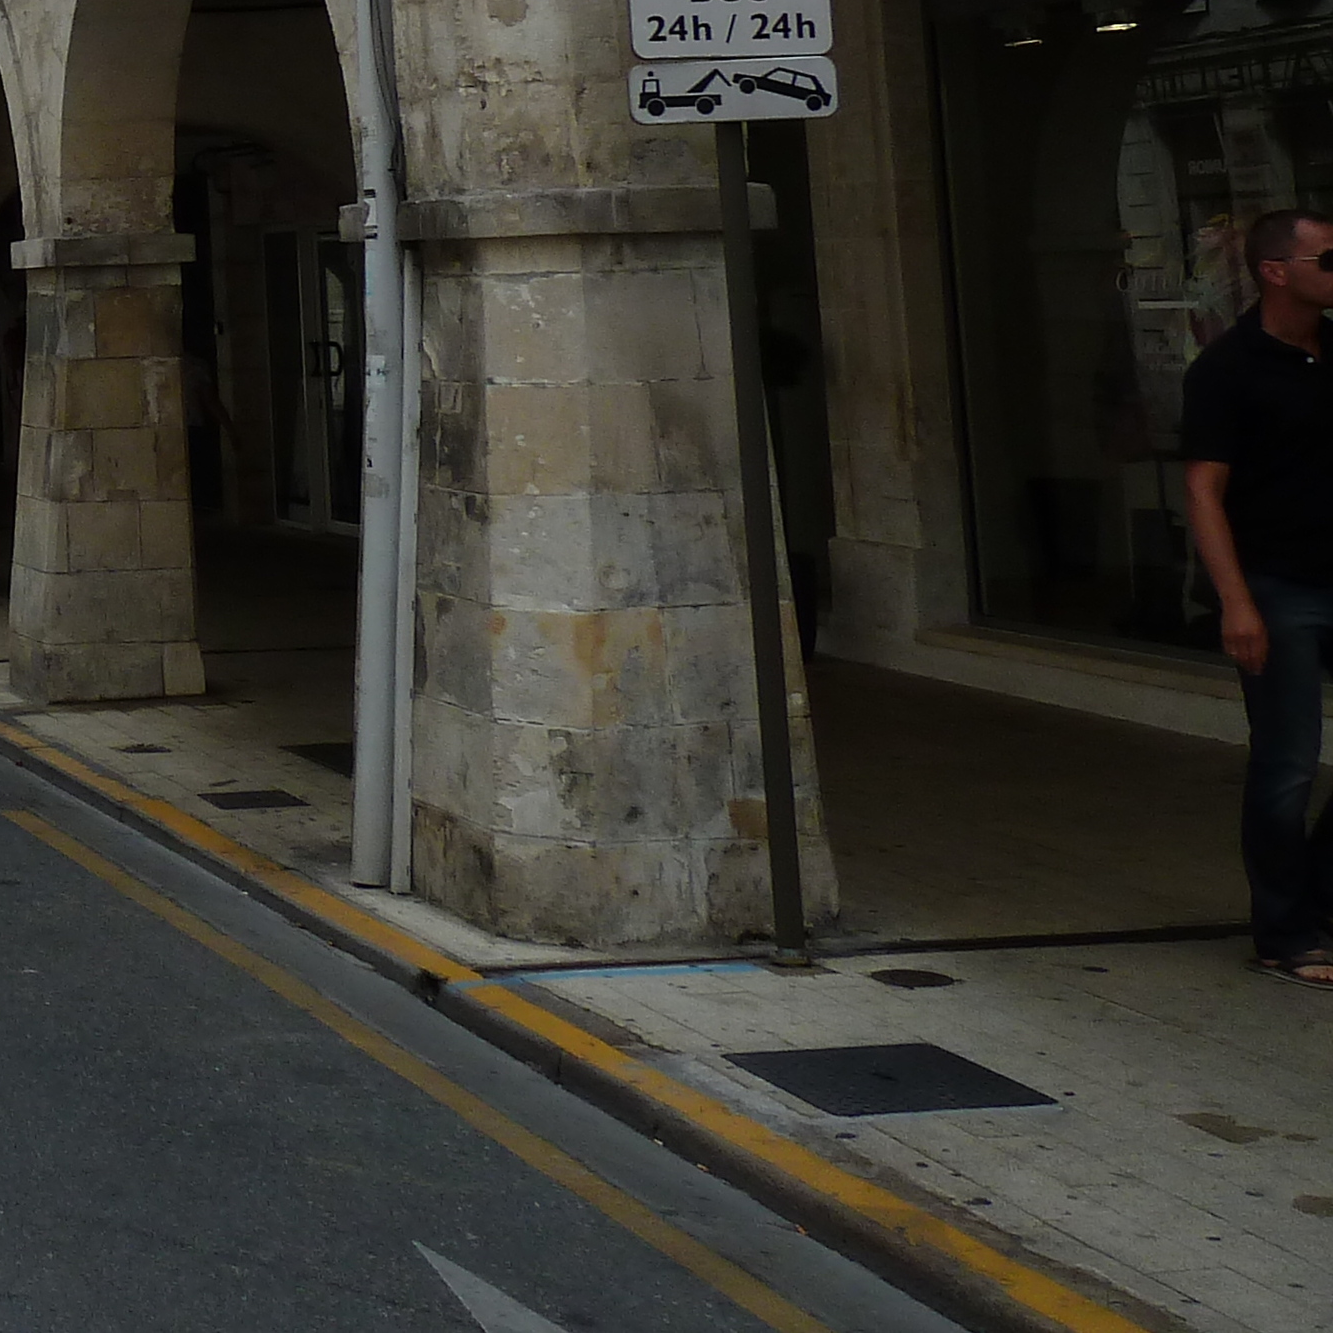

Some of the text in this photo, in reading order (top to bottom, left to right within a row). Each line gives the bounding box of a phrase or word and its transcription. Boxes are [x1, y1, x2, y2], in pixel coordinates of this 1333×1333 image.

[646, 12, 816, 44] 24h / 24h
